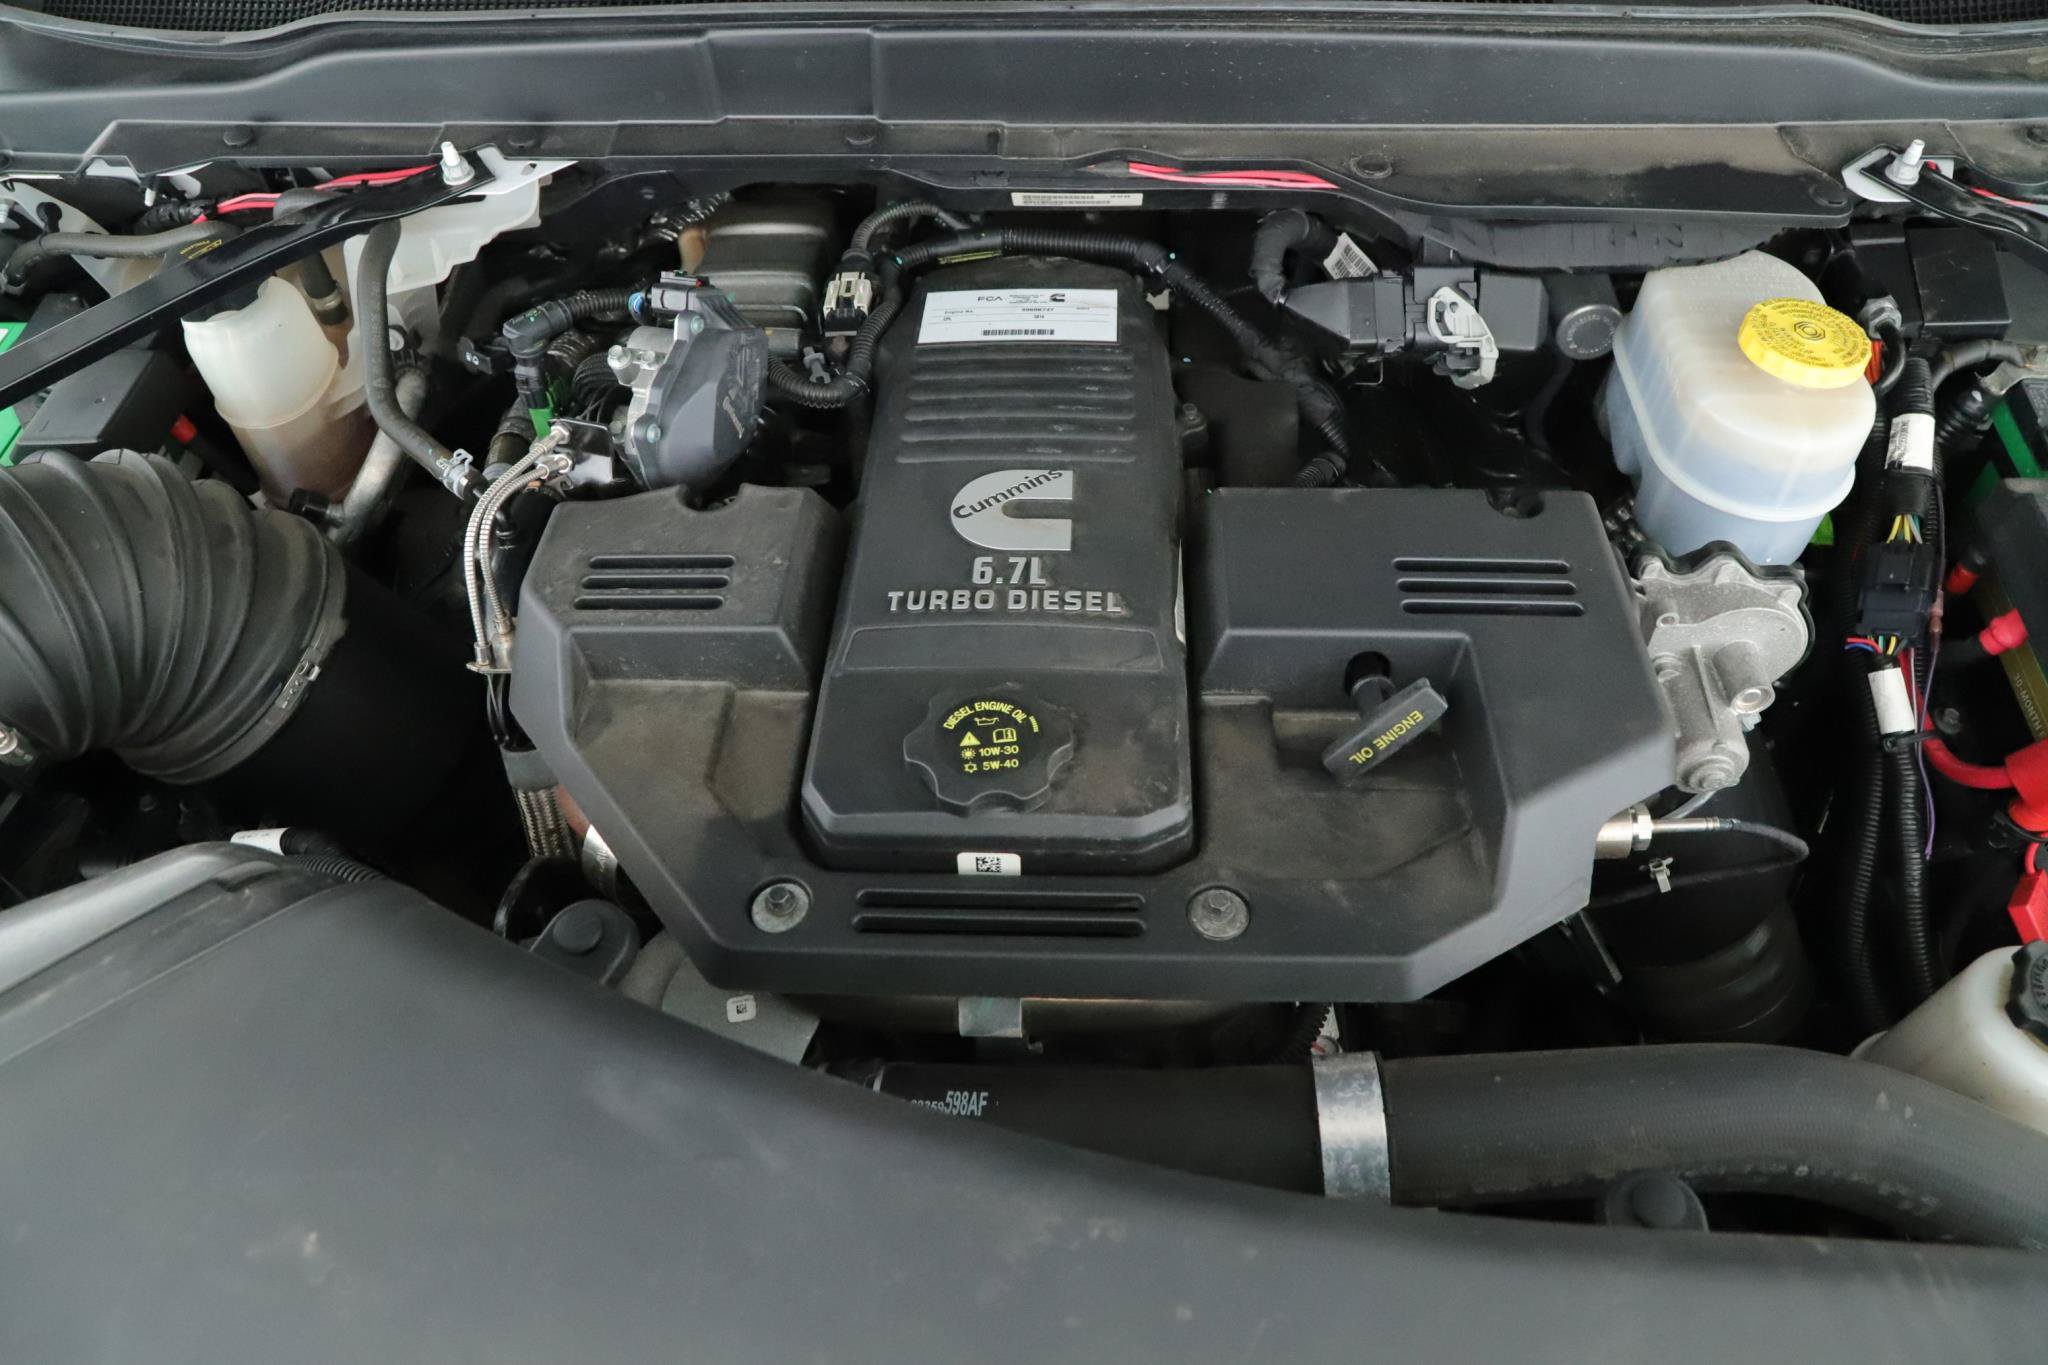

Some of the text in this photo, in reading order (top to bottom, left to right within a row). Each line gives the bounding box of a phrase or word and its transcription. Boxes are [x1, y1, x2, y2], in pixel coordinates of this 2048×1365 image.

[952, 469, 1063, 519] Cummins
[972, 556, 1047, 585] 6.7L
[887, 589, 1122, 612] TURBO DIESEL
[943, 706, 975, 730] DIESEL
[974, 701, 1015, 714] ENGINE
[1011, 709, 1027, 724] OIL
[979, 745, 1019, 757] 10W-30
[1348, 710, 1424, 764] ENGINE OIL
[982, 759, 1019, 771] 5W-40
